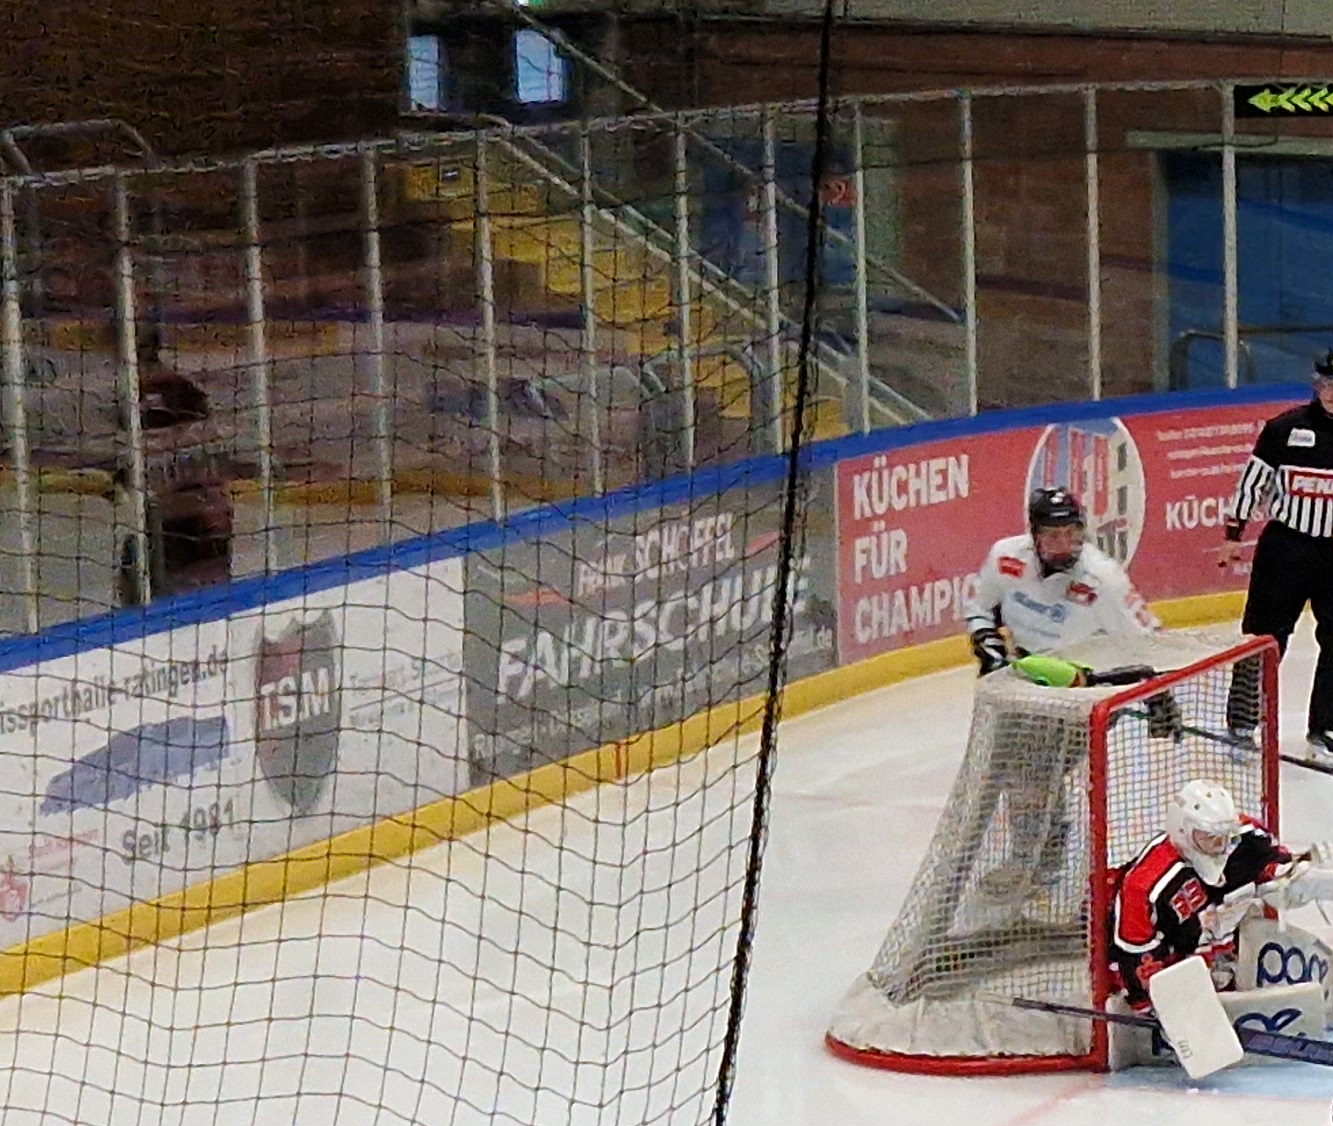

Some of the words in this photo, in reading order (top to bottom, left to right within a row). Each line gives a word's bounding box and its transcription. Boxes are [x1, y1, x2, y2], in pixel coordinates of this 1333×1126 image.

[853, 454, 969, 521] KÜCHEN
[854, 520, 908, 585] FÜR
[259, 667, 333, 732] TSM
[121, 825, 170, 861] Seit
[184, 801, 236, 842] 1981
